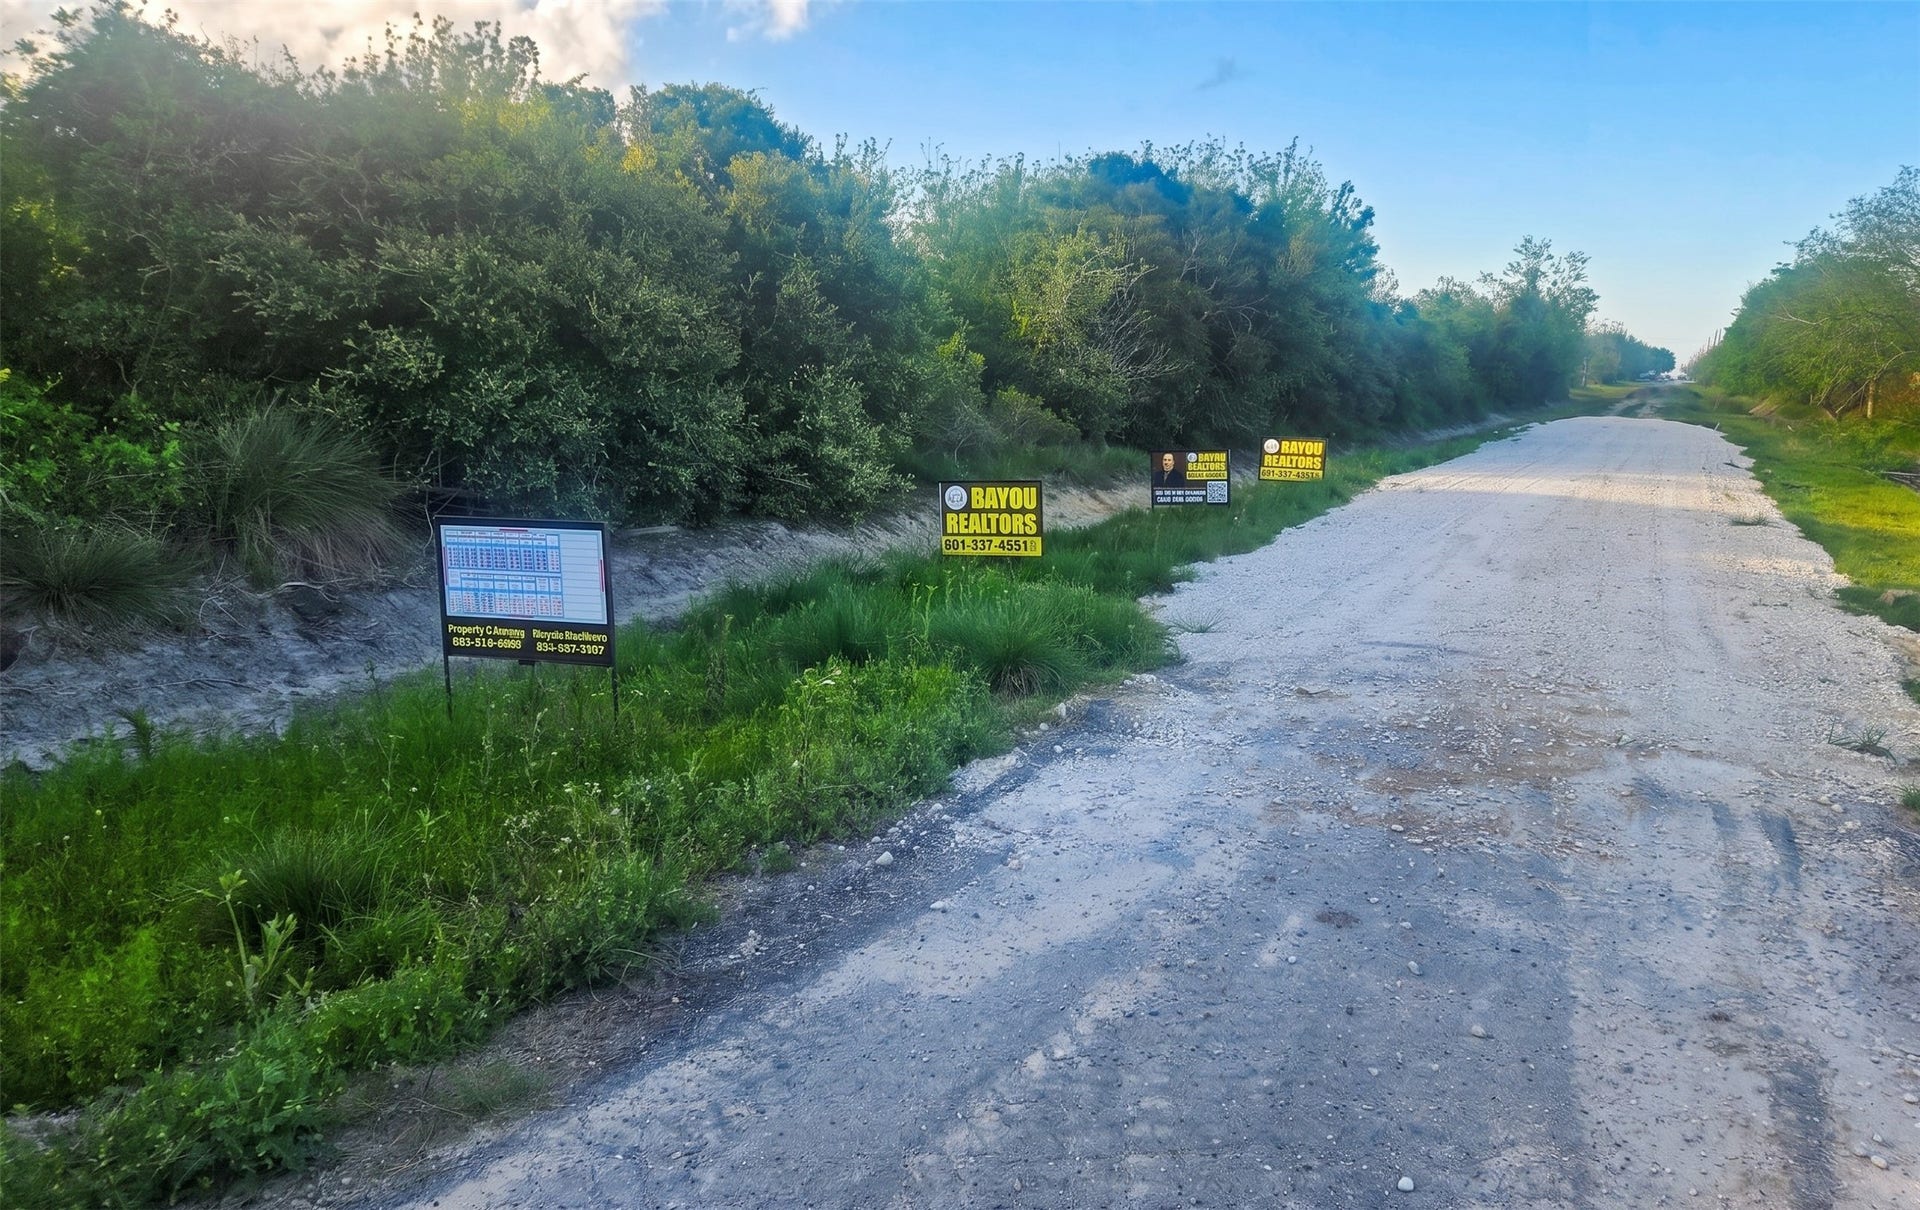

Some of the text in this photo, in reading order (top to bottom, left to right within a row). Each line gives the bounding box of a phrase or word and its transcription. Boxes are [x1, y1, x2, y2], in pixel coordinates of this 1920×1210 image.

[1264, 455, 1321, 469] REALTORS
[971, 487, 1037, 509] BAYOU
[946, 513, 1037, 534] REALTORS
[944, 539, 1028, 551] 601-337-4551
[448, 624, 485, 637] Property
